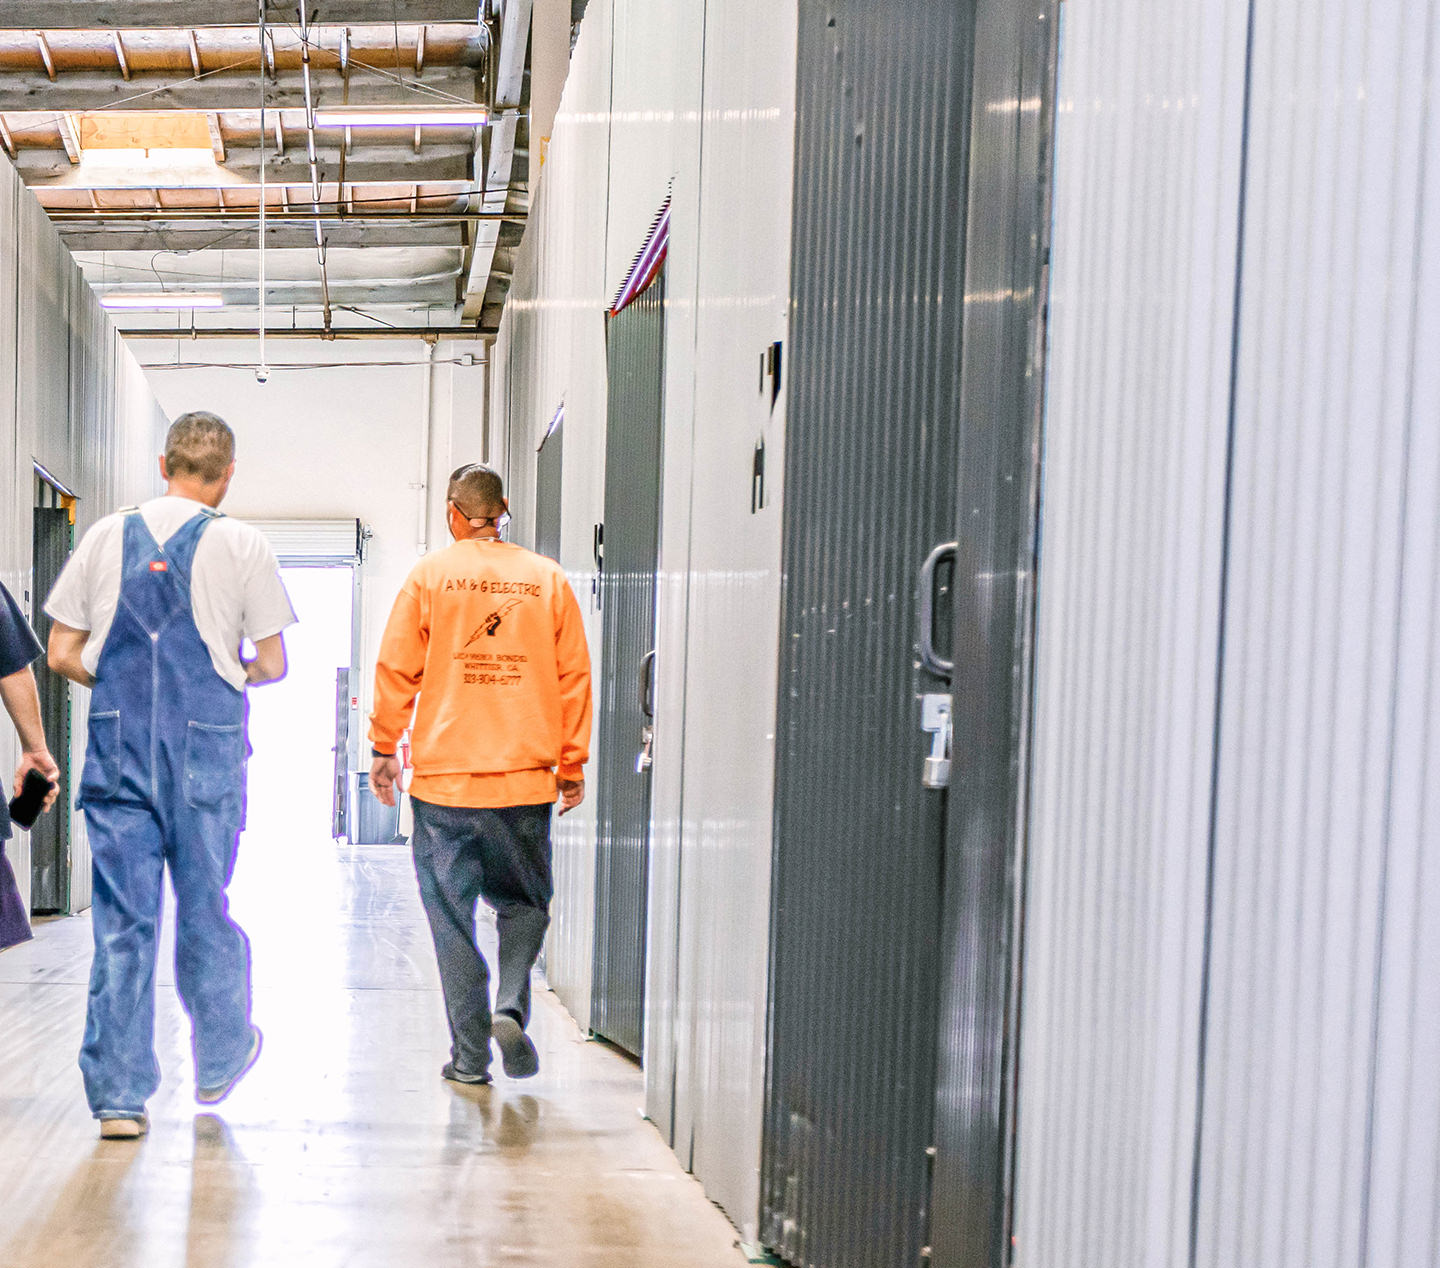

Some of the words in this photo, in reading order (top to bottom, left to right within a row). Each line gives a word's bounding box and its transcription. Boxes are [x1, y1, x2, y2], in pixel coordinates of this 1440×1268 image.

[469, 578, 478, 591] &
[480, 580, 488, 593] G
[490, 582, 540, 597] ELECTRIC
